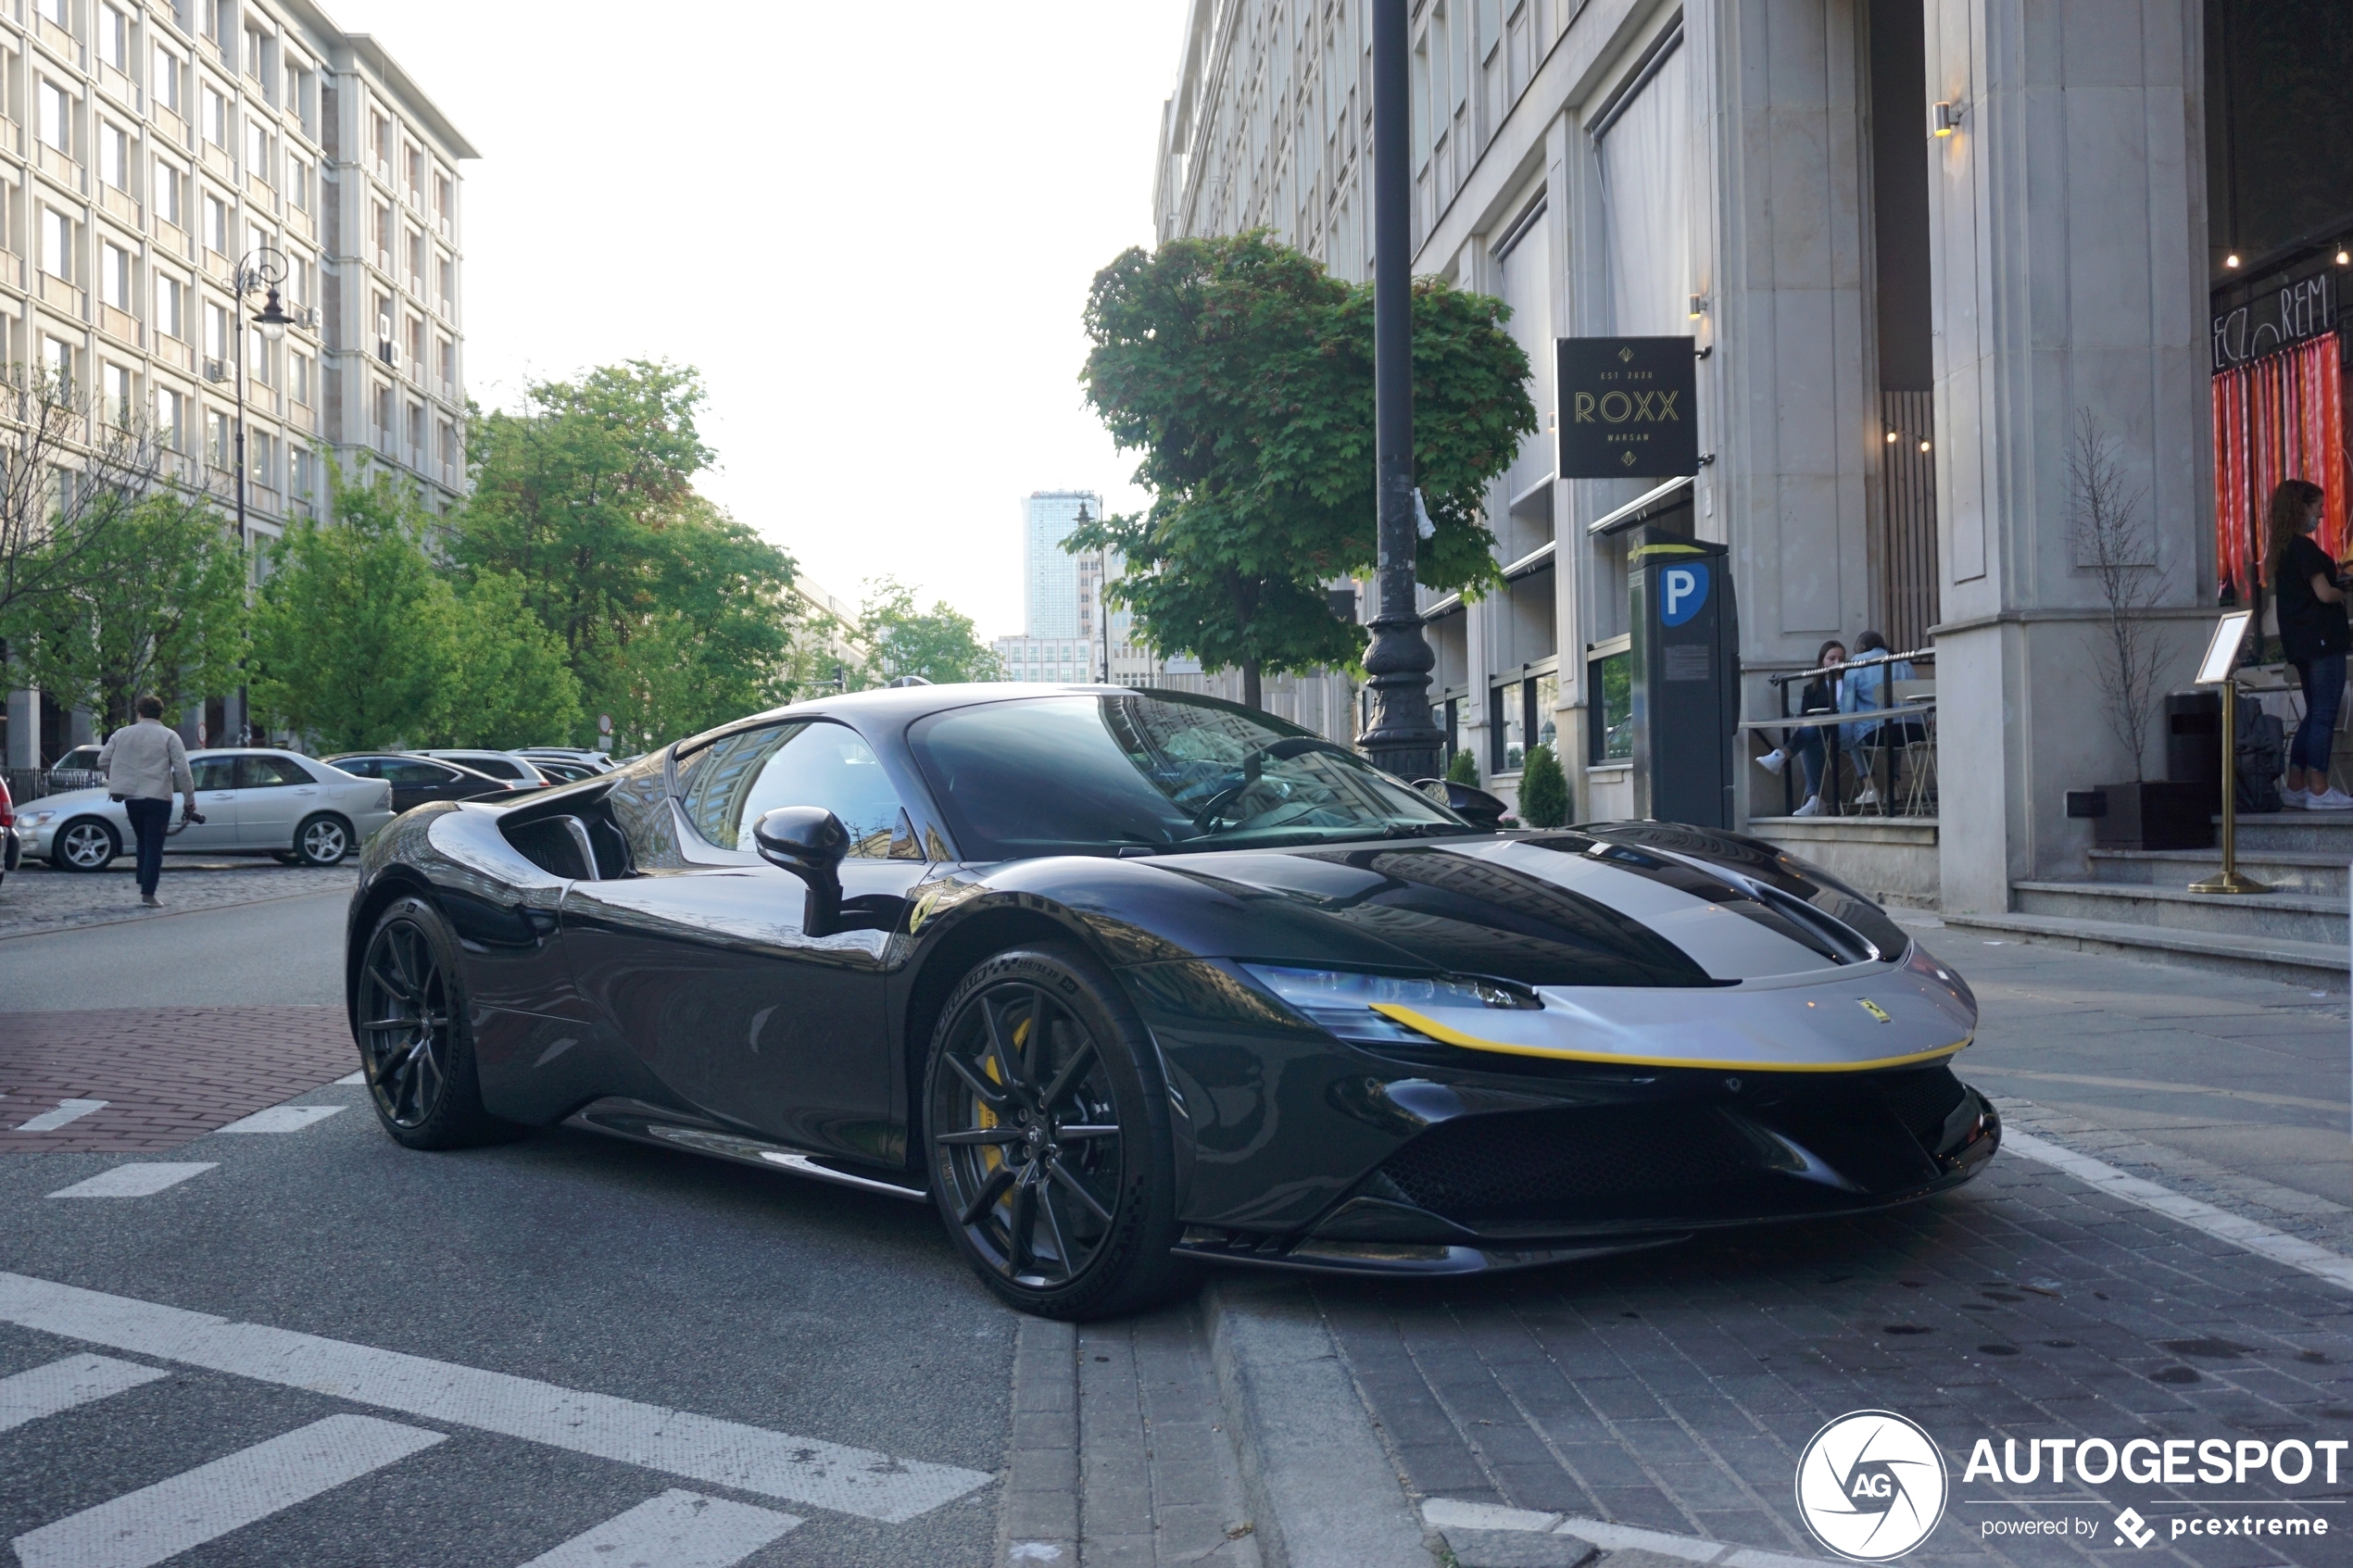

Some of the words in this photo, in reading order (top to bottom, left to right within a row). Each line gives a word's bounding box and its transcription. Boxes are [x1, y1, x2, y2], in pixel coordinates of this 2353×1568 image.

[1601, 371, 1618, 380] EST
[1628, 371, 1653, 380] 2020
[1575, 390, 1679, 422] ROXX
[1607, 433, 1649, 442] WARSAW
[1667, 570, 1696, 615] P
[1017, 960, 1048, 973] 255/35
[938, 968, 987, 1031] MICHELIN
